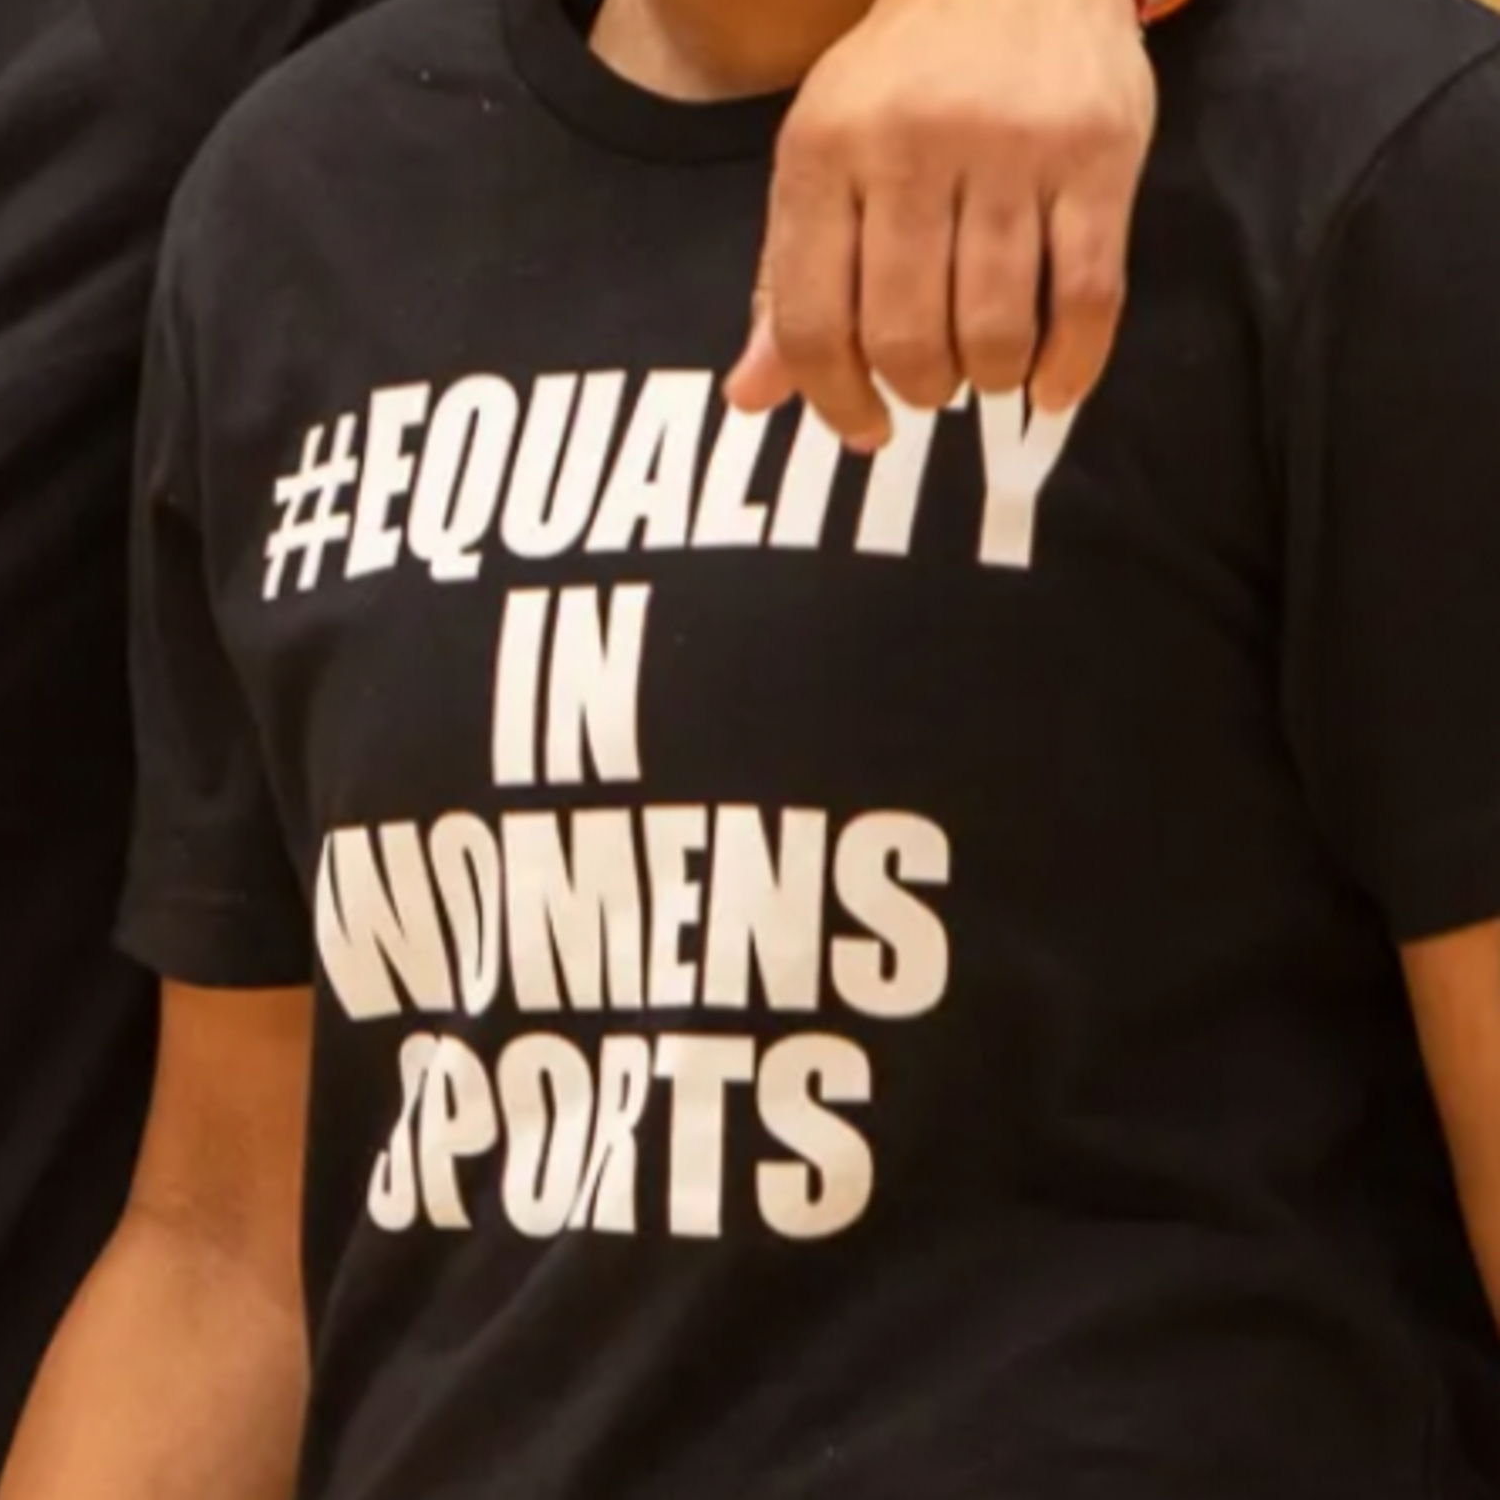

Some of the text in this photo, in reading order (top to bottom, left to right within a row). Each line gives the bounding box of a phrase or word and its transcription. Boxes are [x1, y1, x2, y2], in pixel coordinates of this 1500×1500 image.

[261, 368, 1080, 602] #EQUALITY
[491, 581, 653, 787] IN
[314, 803, 950, 1022] WOMENS
[366, 1032, 874, 1239] SPORTS
